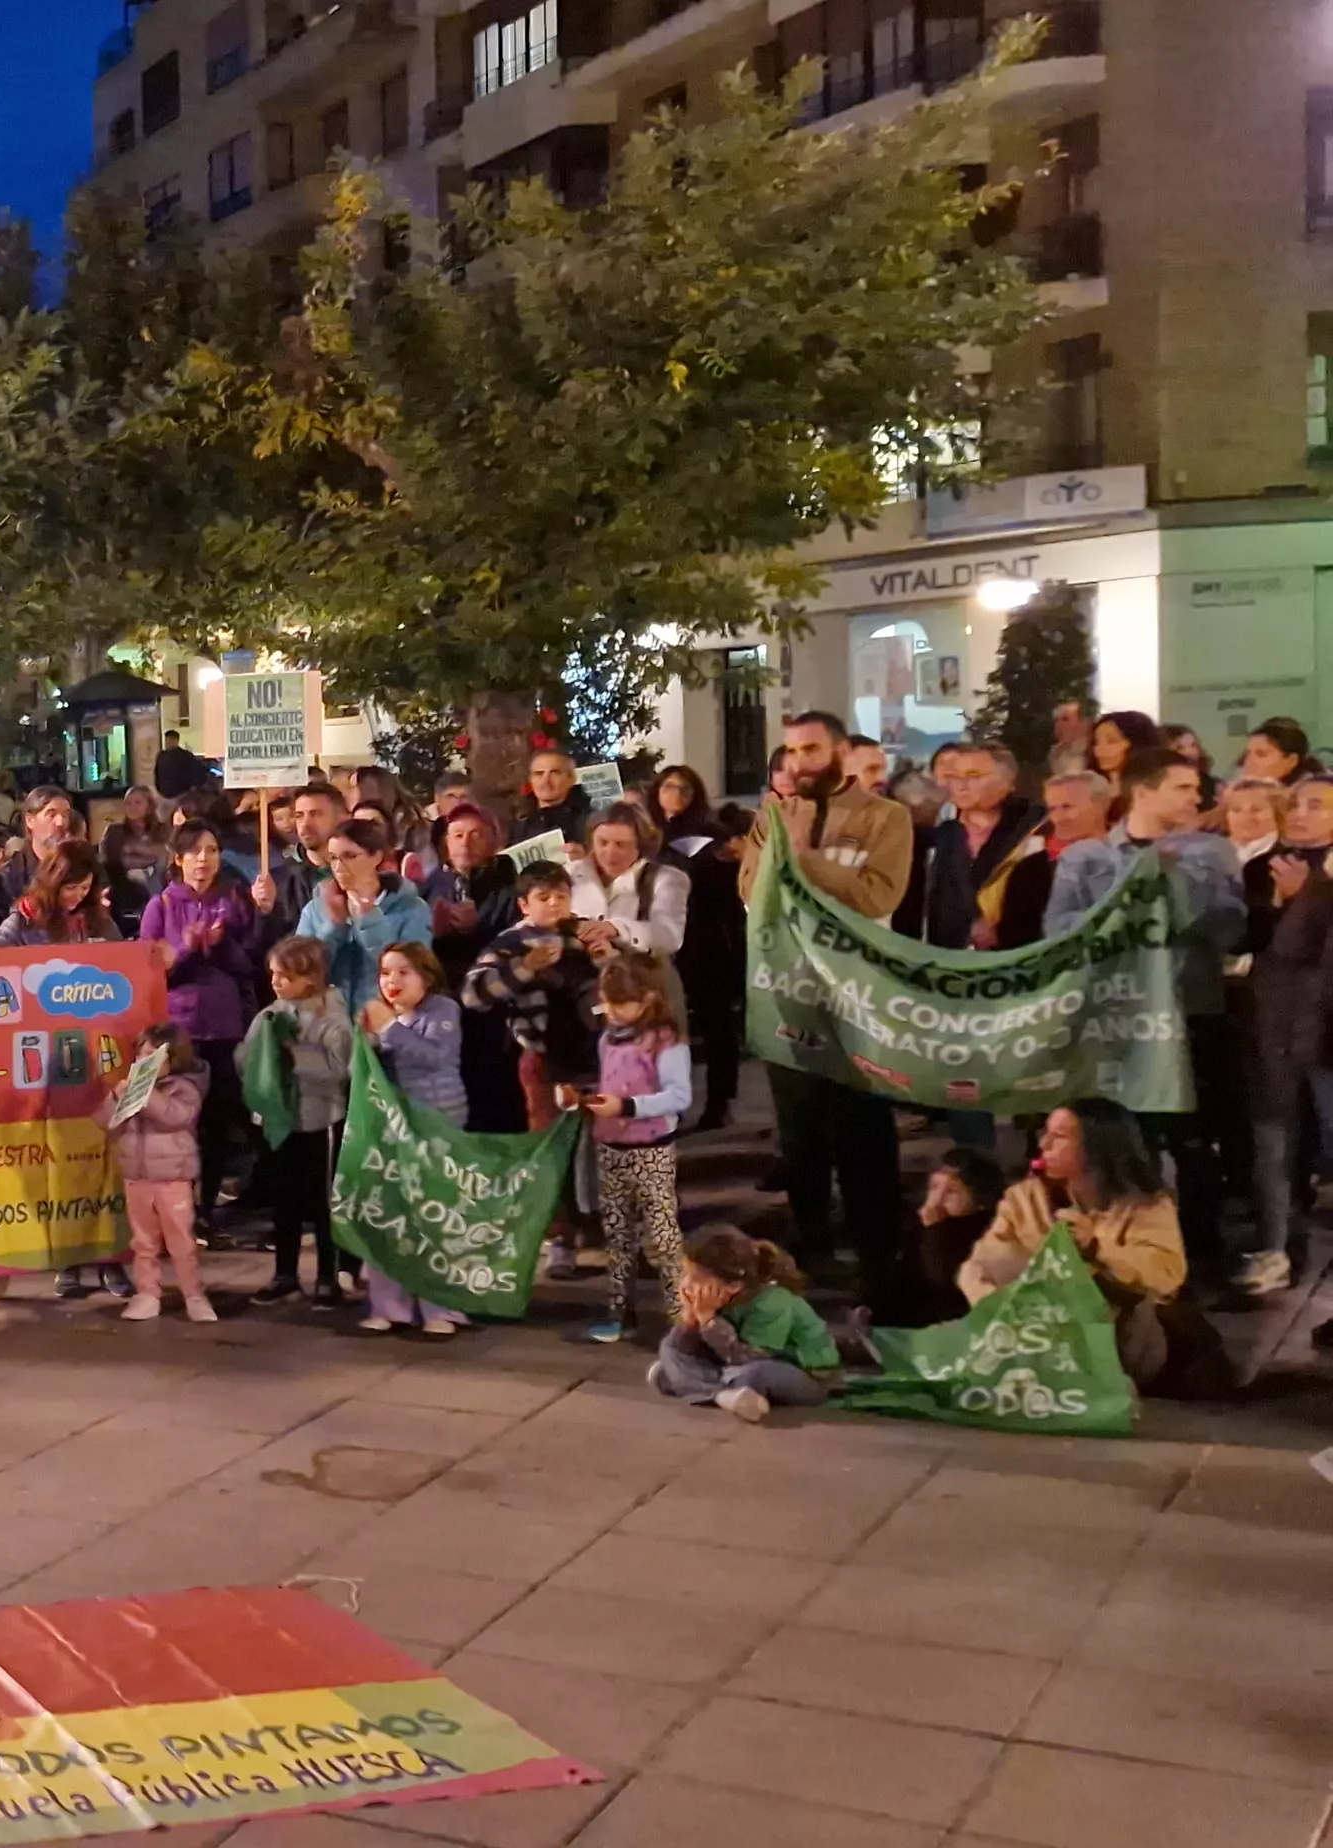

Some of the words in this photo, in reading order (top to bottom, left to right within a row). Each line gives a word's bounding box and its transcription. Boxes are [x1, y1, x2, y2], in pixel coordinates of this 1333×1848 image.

[870, 555, 1040, 597] VITALDENT
[247, 680, 283, 710] NO!
[230, 713, 242, 728] AL
[244, 710, 303, 727] CONCIERTO
[229, 727, 287, 744] EDUCATIVO
[51, 980, 116, 1004] CRÍTICA
[886, 988, 1084, 1037] CONCIERTO
[1092, 973, 1145, 1004] DEL
[980, 1043, 1004, 1065] Y
[36, 1195, 126, 1224] PINTAMO
[159, 1706, 464, 1762] PINTAMOS
[102, 1766, 279, 1813] Pública
[285, 1748, 468, 1791] HUESCA
